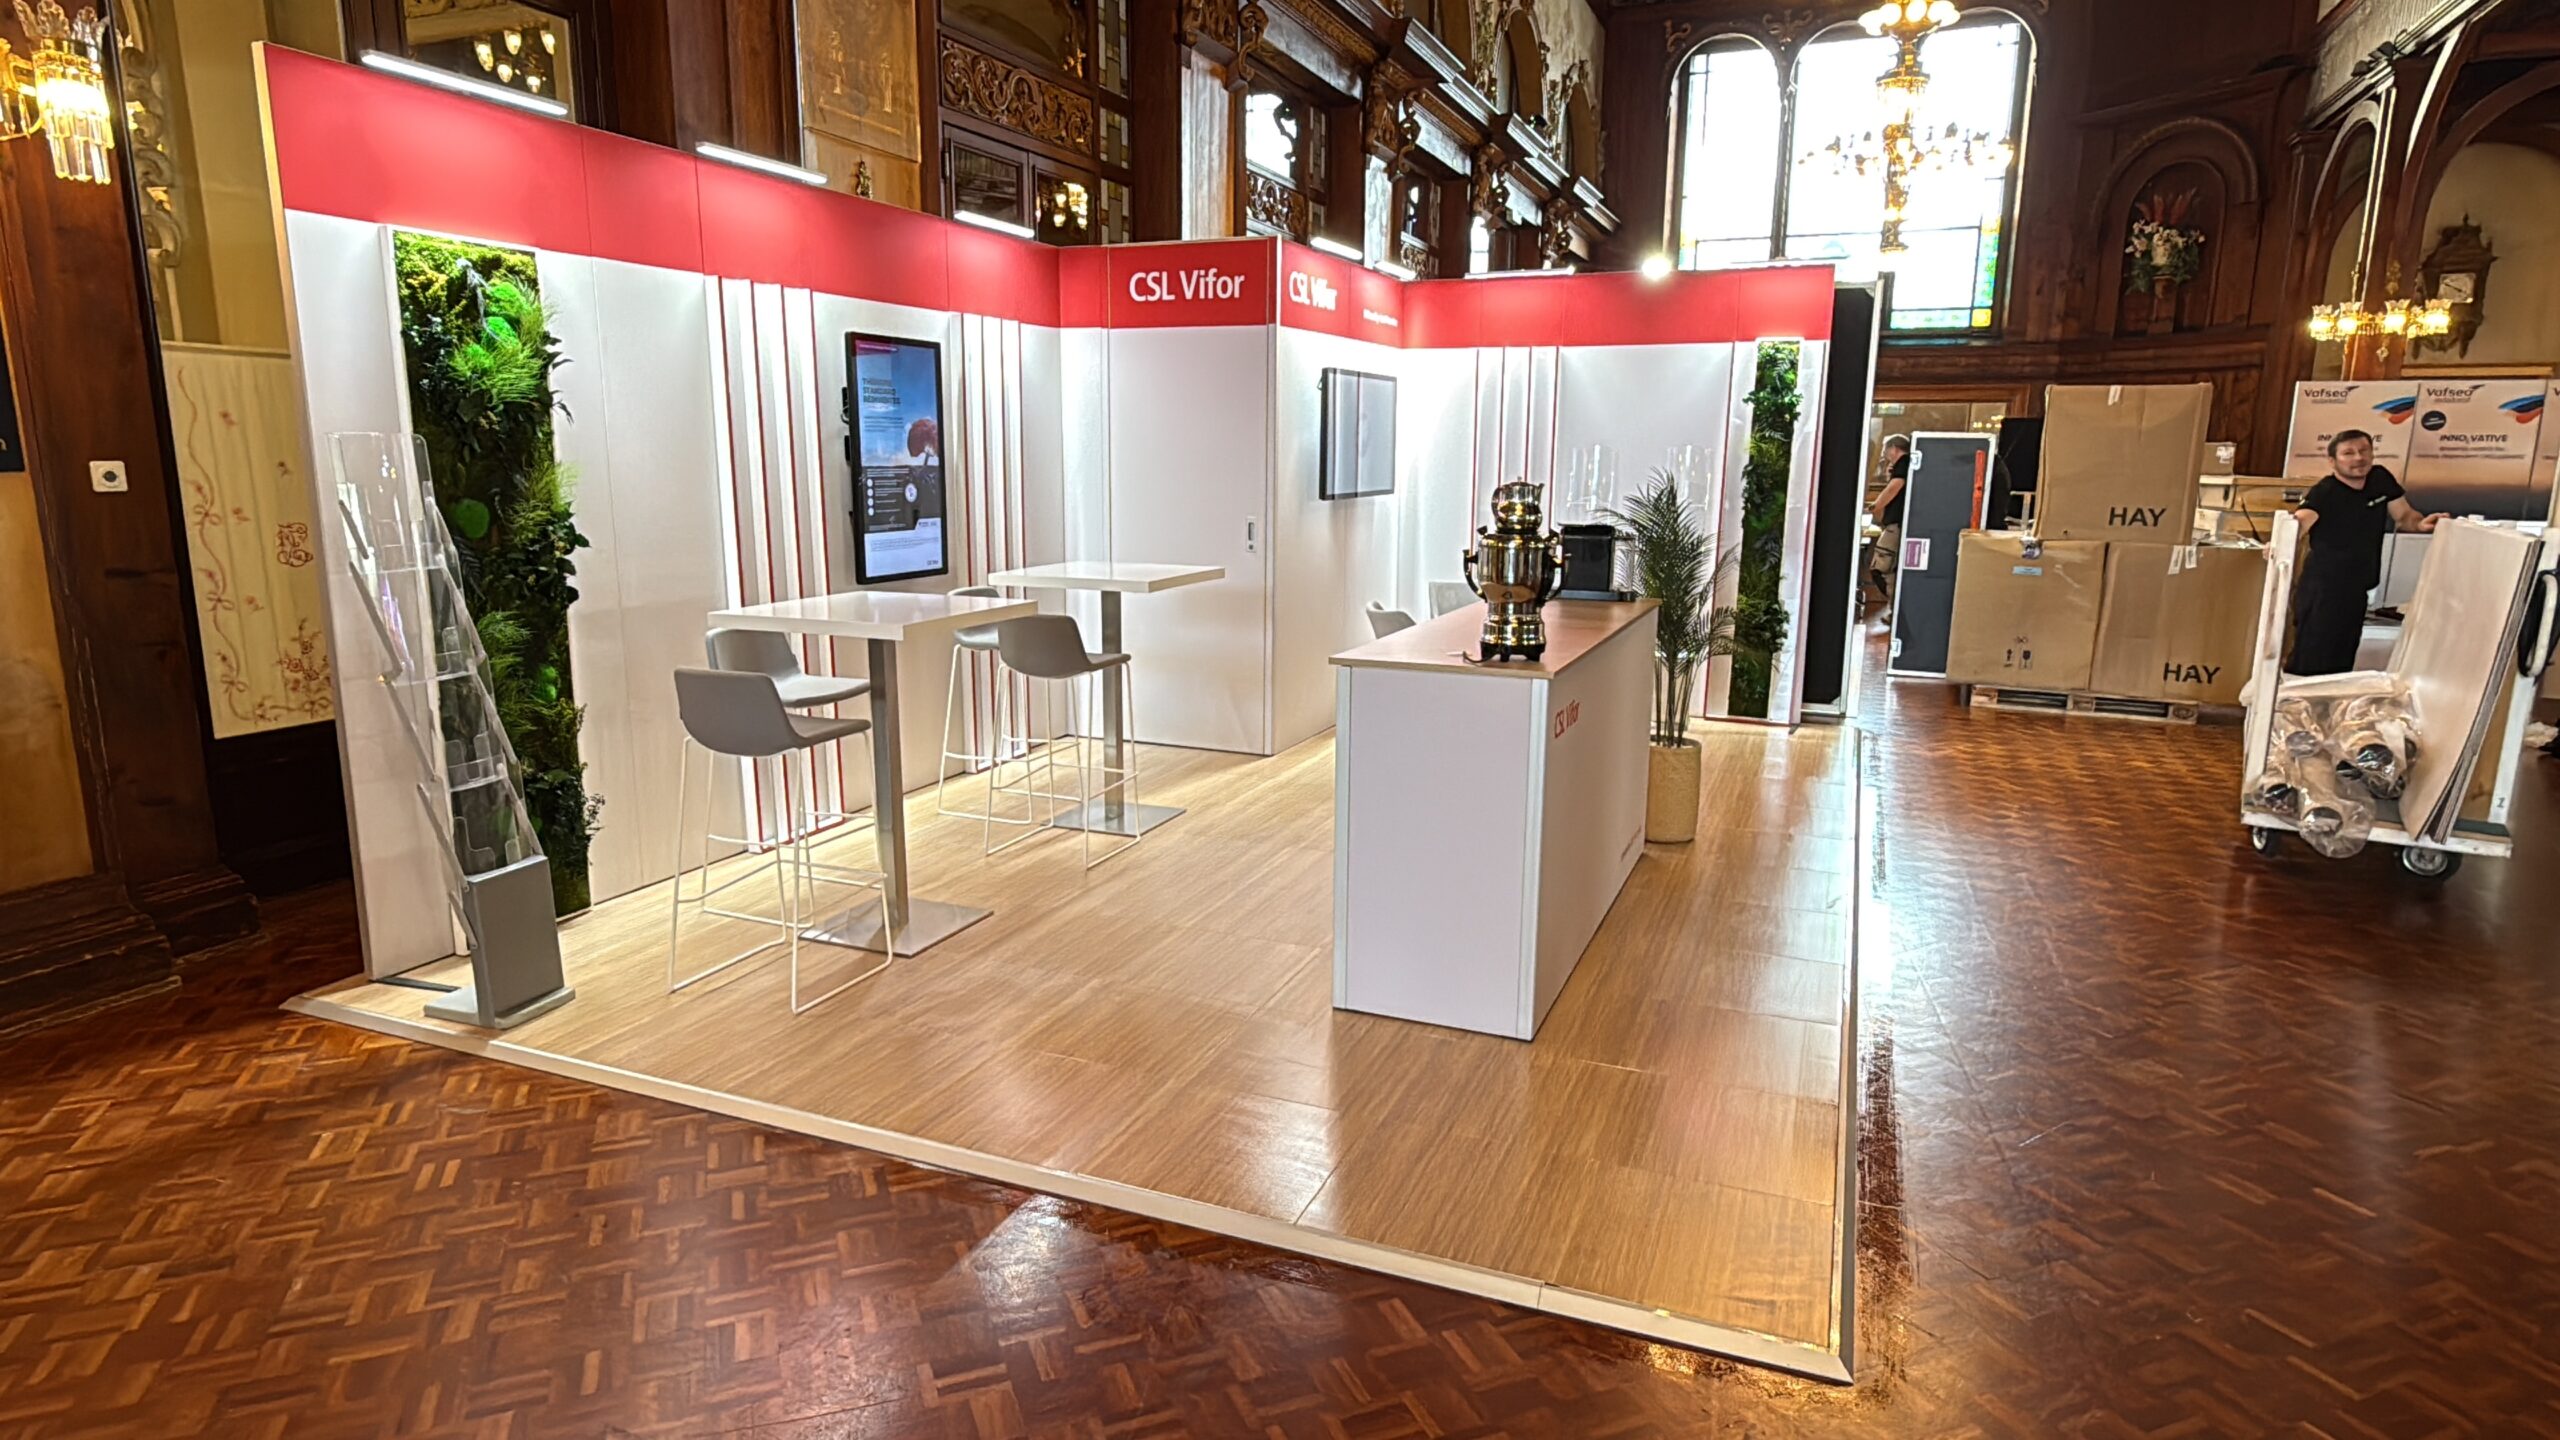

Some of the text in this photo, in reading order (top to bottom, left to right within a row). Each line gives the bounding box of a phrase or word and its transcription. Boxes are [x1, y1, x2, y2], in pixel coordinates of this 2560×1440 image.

[1129, 267, 1245, 302] CSL Vifor
[1289, 270, 1310, 305] CSL
[2304, 387, 2350, 399] Vafsea
[2427, 386, 2475, 397] Vafsea
[2108, 506, 2166, 527] HAY
[2163, 661, 2221, 684] HAY
